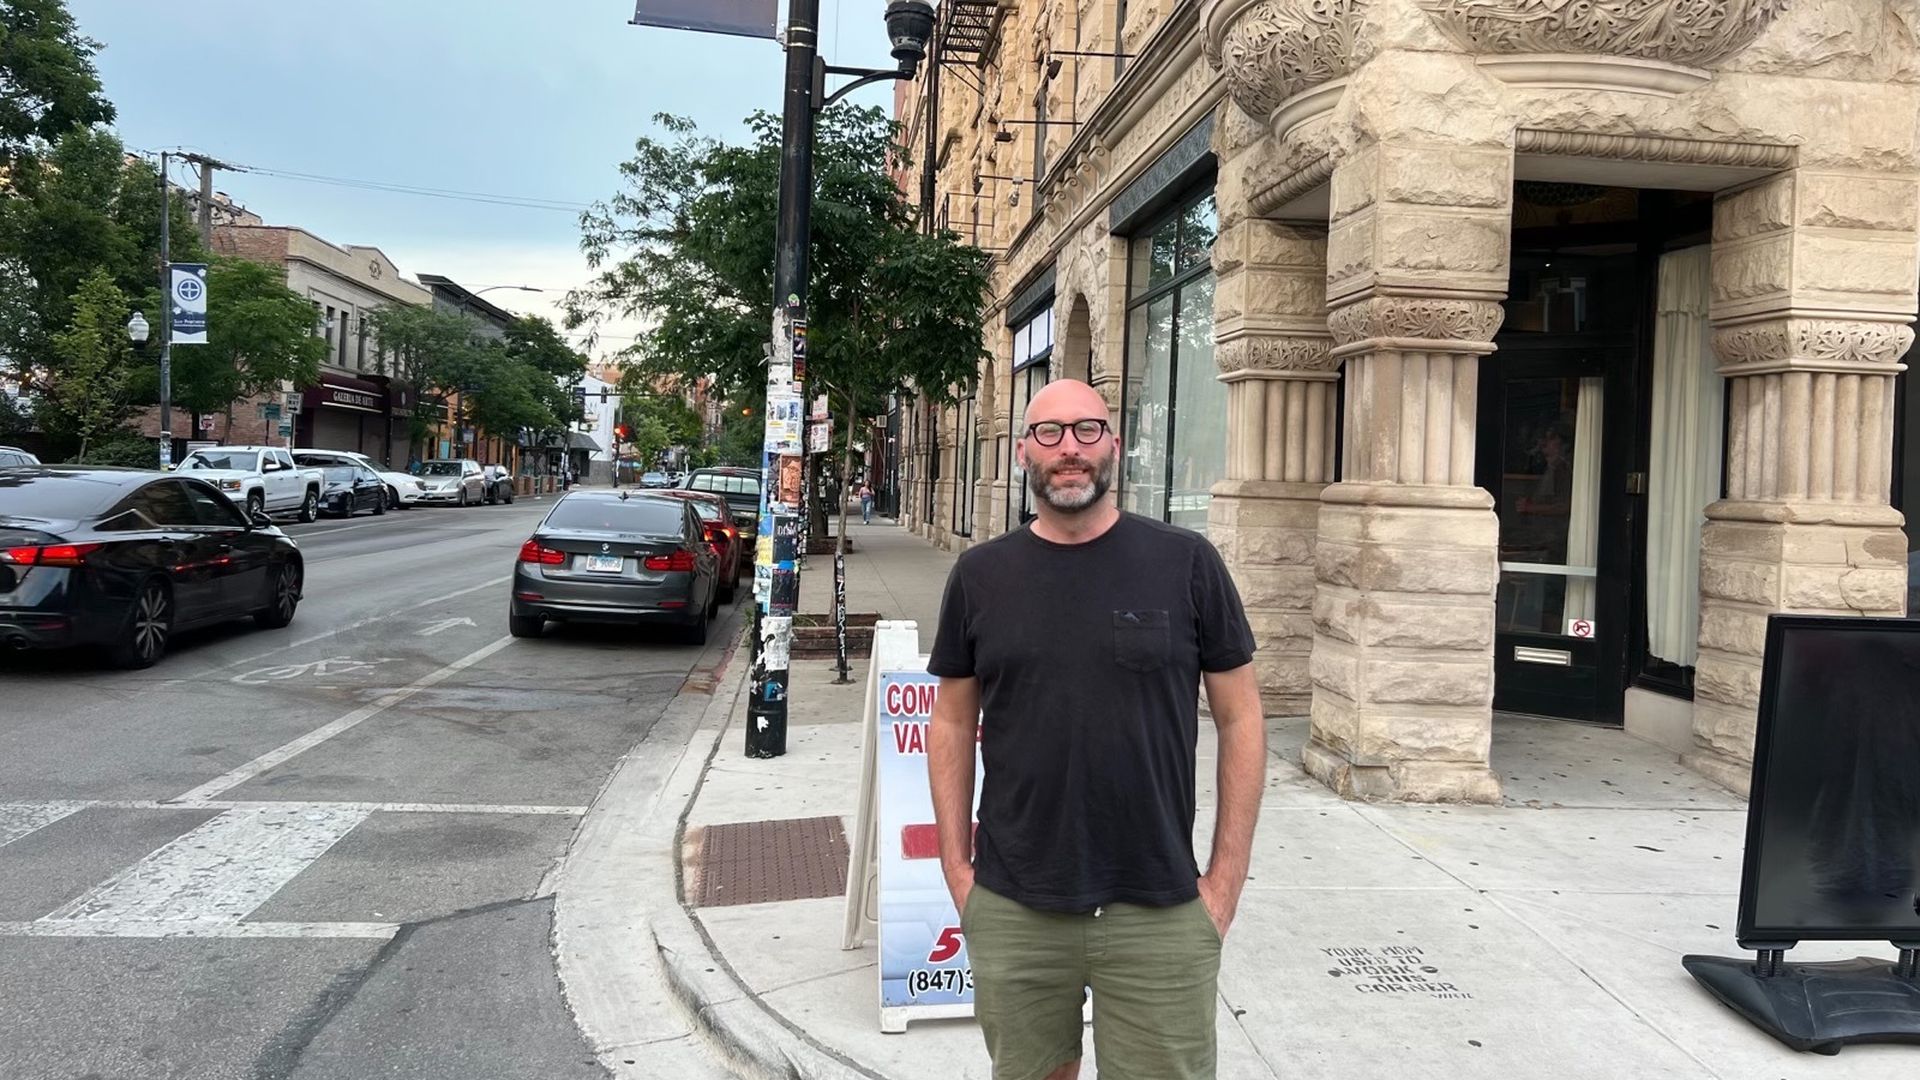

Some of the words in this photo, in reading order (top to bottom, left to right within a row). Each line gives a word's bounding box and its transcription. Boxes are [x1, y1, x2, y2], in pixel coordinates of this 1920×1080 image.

[333, 391, 356, 404] GALERIA
[355, 395, 362, 405] DE
[362, 396, 374, 407] ARTE
[887, 684, 939, 714] COM
[1320, 947, 1373, 957] YOUR
[1380, 946, 1424, 955] MOM
[1338, 957, 1388, 966] USED
[1391, 955, 1421, 964] TO
[1332, 965, 1415, 975] WORK
[1367, 975, 1427, 983] THIS
[1355, 982, 1458, 993] CORNER
